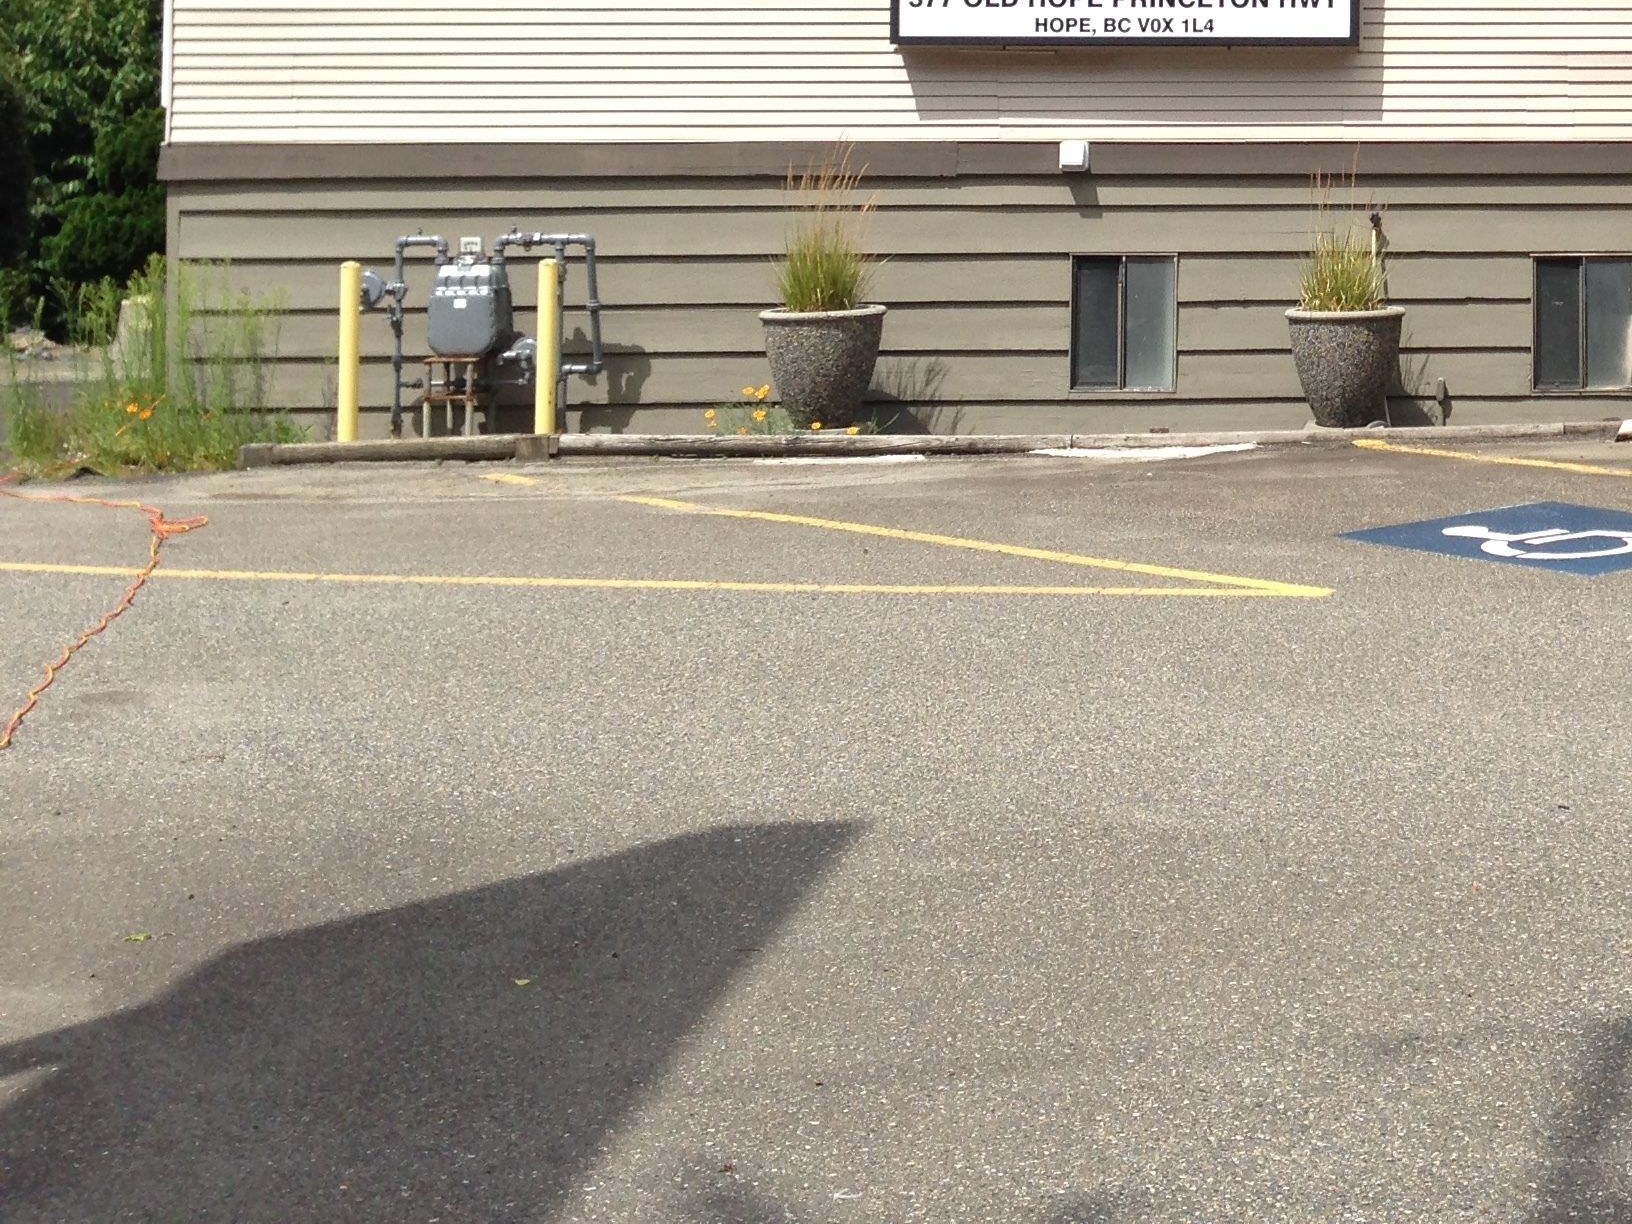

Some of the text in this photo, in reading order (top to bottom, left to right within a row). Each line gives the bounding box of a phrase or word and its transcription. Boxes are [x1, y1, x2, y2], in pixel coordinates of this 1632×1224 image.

[1034, 17, 1097, 36] HOPE,
[1103, 17, 1131, 34] BC
[1181, 17, 1215, 34] 1L4
